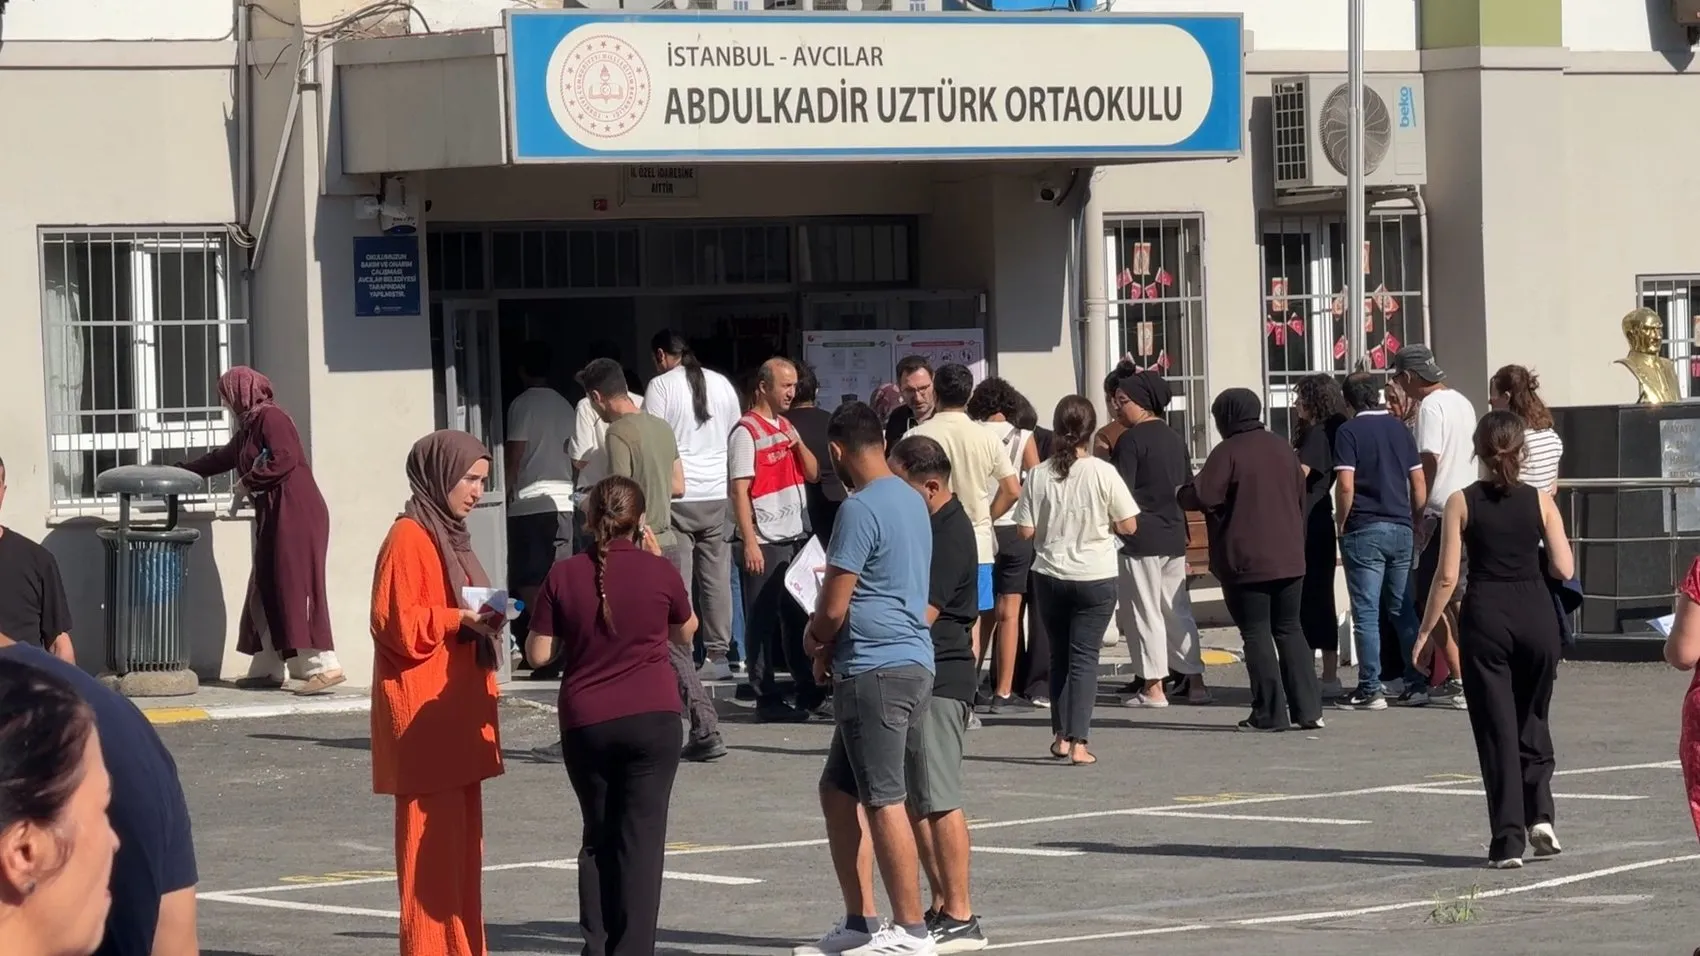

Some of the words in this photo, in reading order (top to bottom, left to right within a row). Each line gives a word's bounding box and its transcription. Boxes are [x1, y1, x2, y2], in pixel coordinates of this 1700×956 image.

[667, 42, 774, 67] İSTANBUL
[793, 46, 883, 67] AVCILAR
[664, 78, 869, 125] ABDULKADİR
[877, 77, 998, 124] UZTÜRK
[1005, 85, 1182, 123] ORTAOKULU
[1398, 86, 1410, 127] beko
[638, 164, 656, 178] ÖZEL
